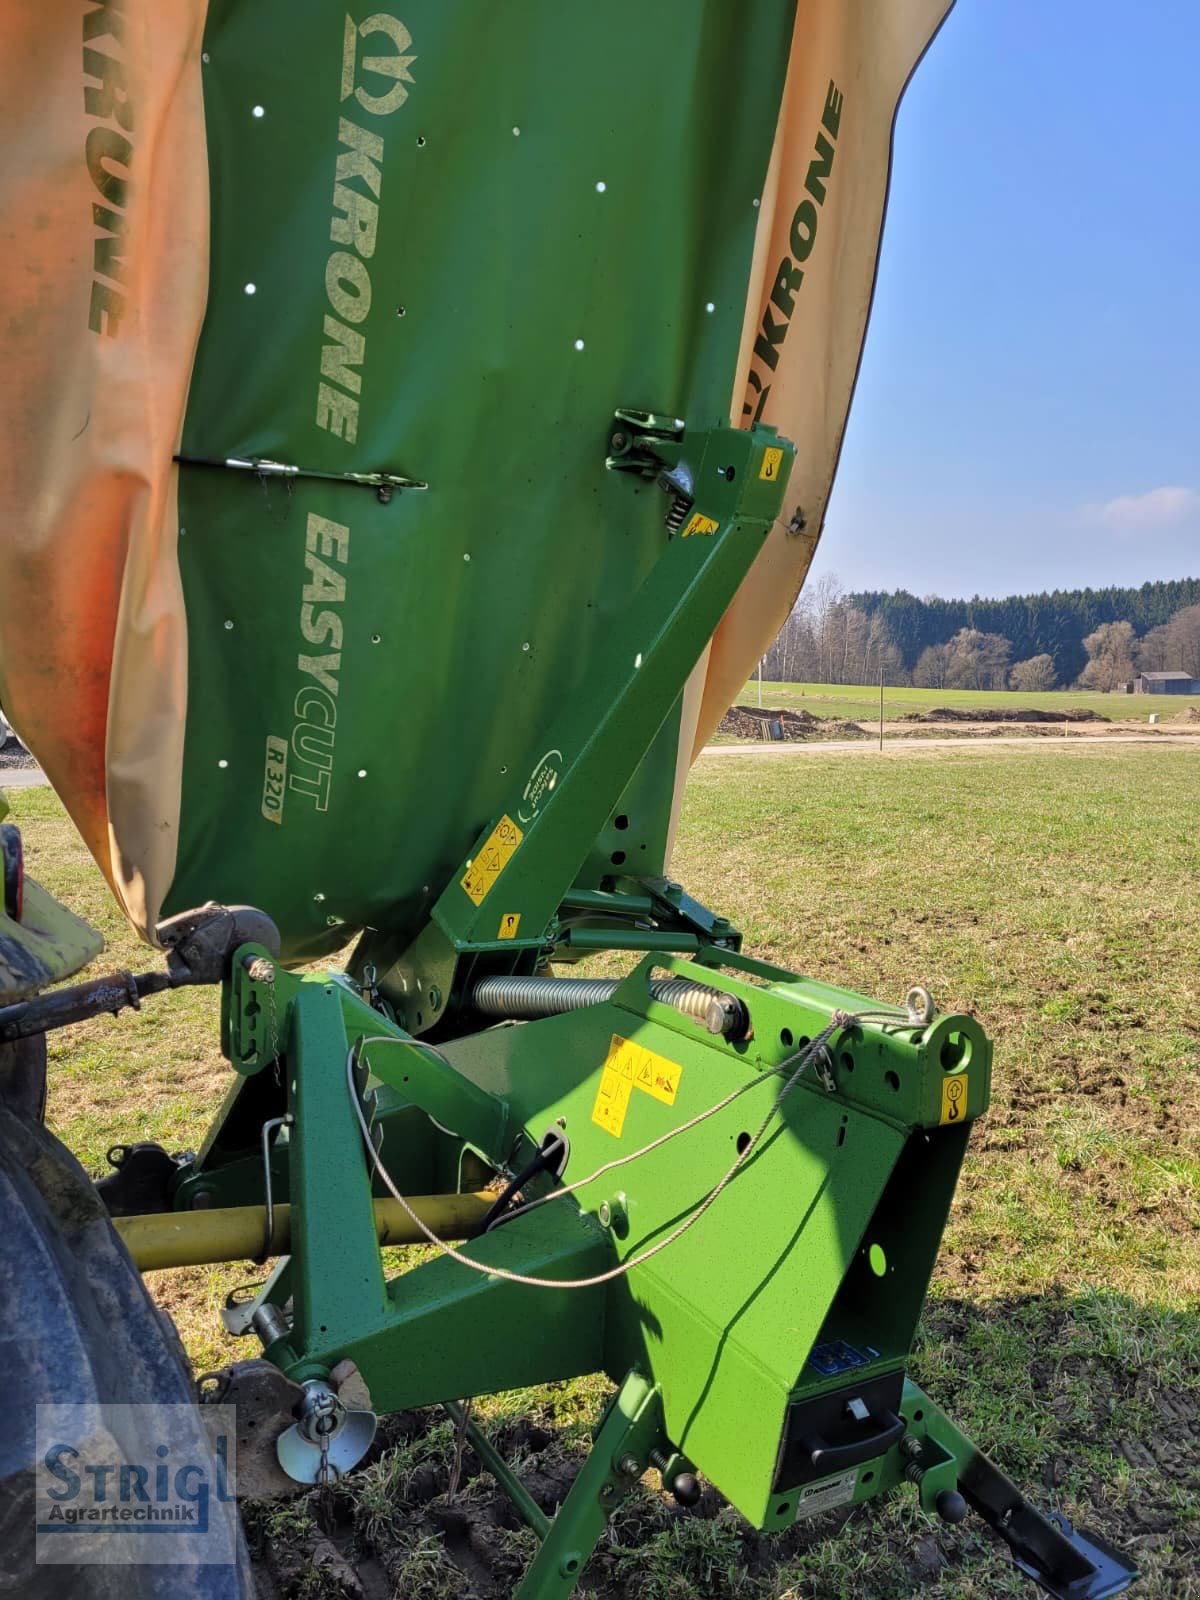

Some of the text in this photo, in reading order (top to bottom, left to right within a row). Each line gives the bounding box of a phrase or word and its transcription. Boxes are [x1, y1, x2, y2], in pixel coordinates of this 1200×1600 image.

[316, 116, 384, 444] KRONE
[753, 79, 843, 372] KRONE
[264, 748, 284, 810] R 320
